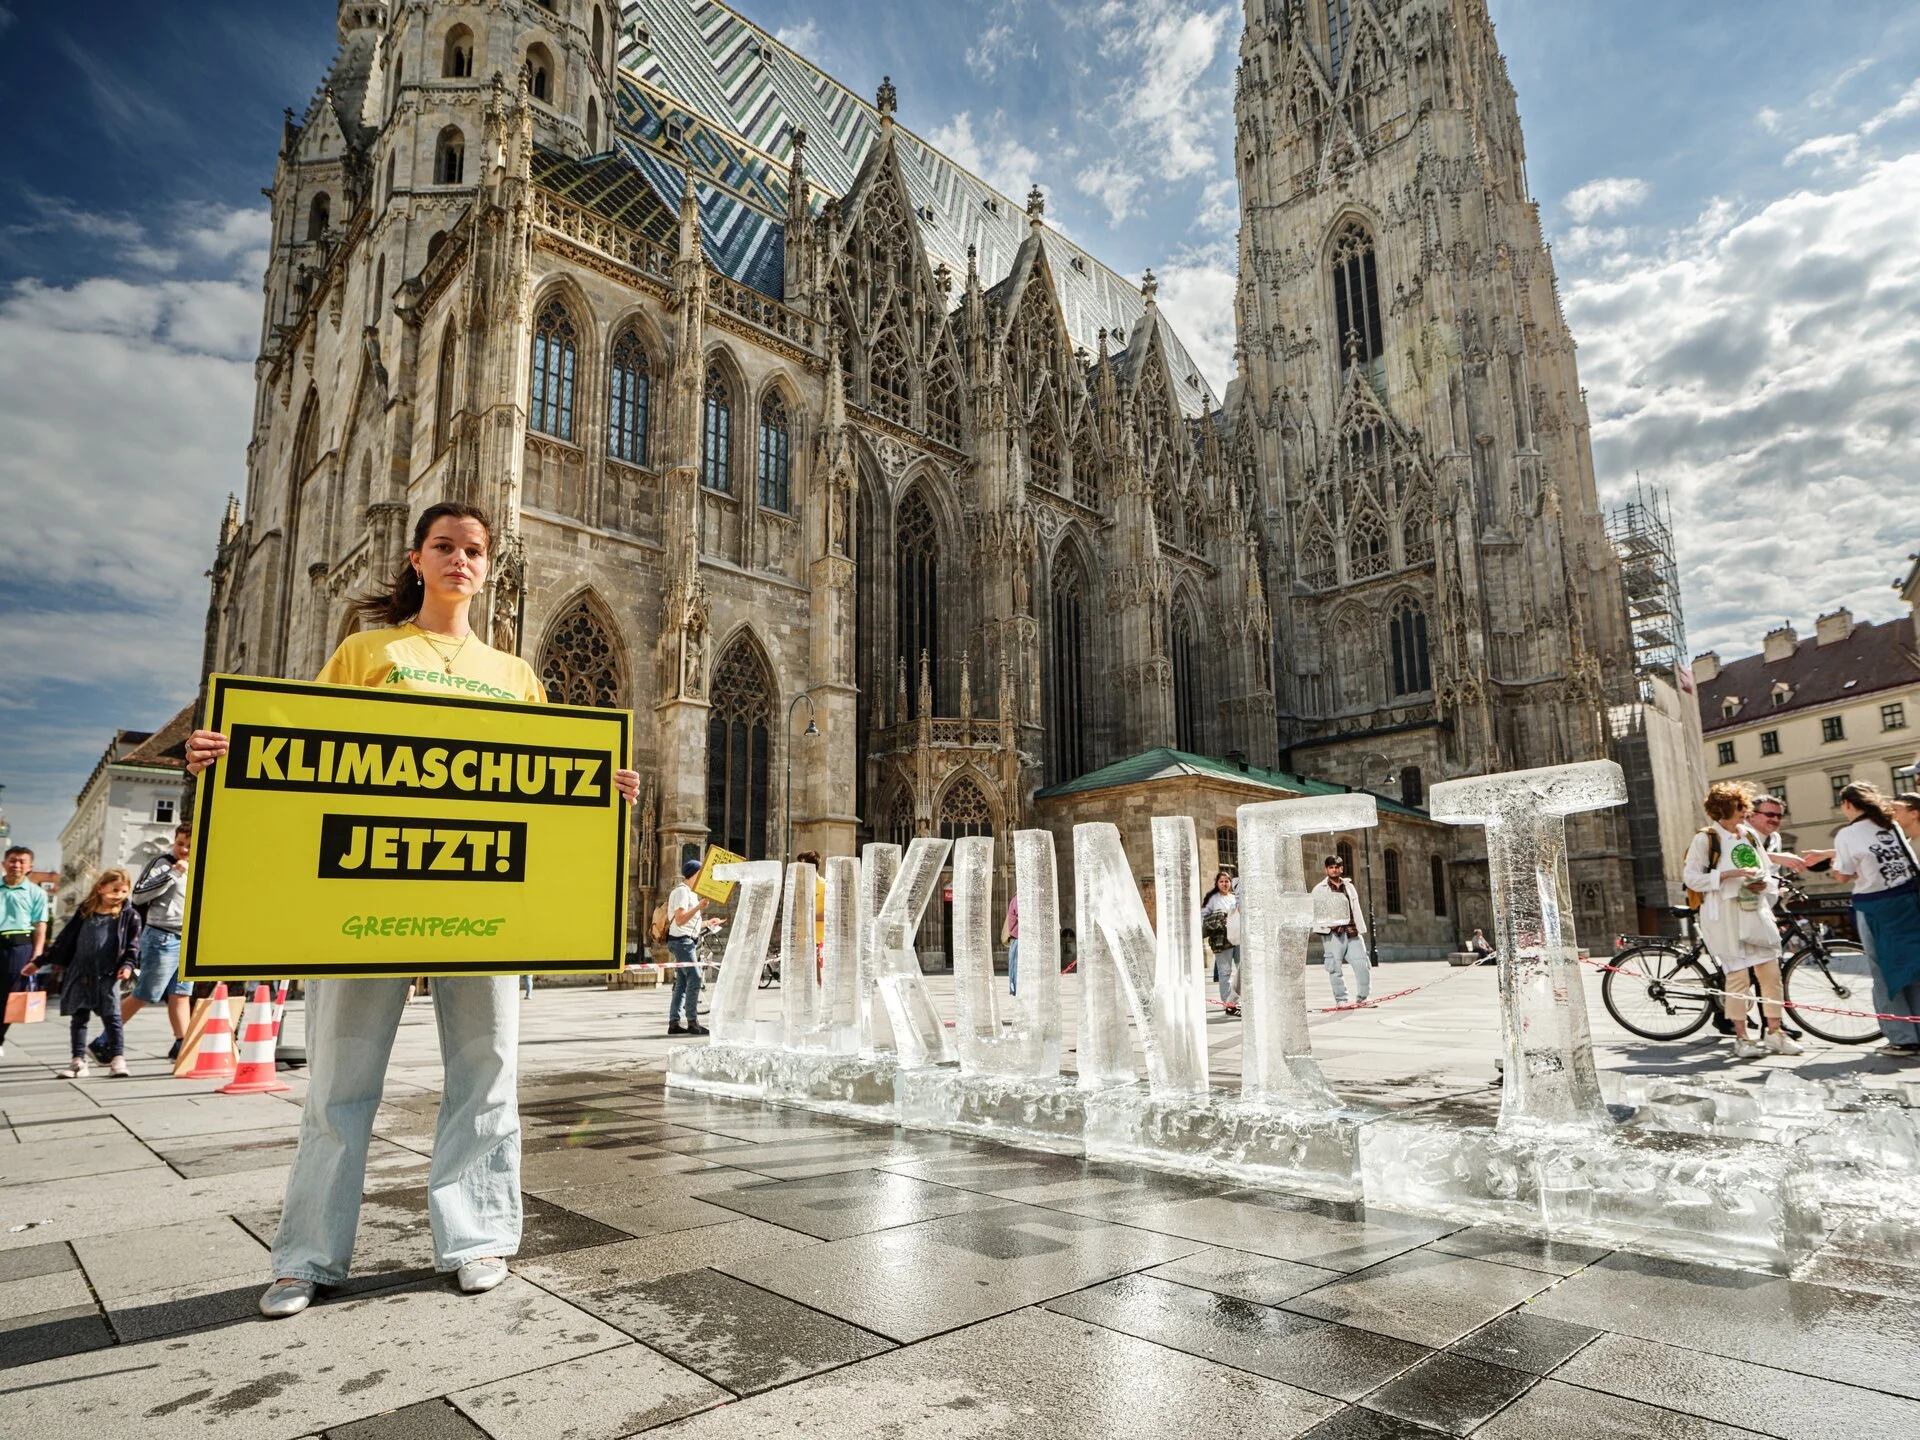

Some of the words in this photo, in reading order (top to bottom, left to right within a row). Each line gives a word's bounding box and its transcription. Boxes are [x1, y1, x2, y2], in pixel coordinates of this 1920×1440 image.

[246, 736, 602, 797] KLIMASCHUTZ
[338, 826, 511, 873] JETZT!
[341, 915, 506, 939] GREENPEACE
[708, 758, 1629, 1136] ZUKUNFT
